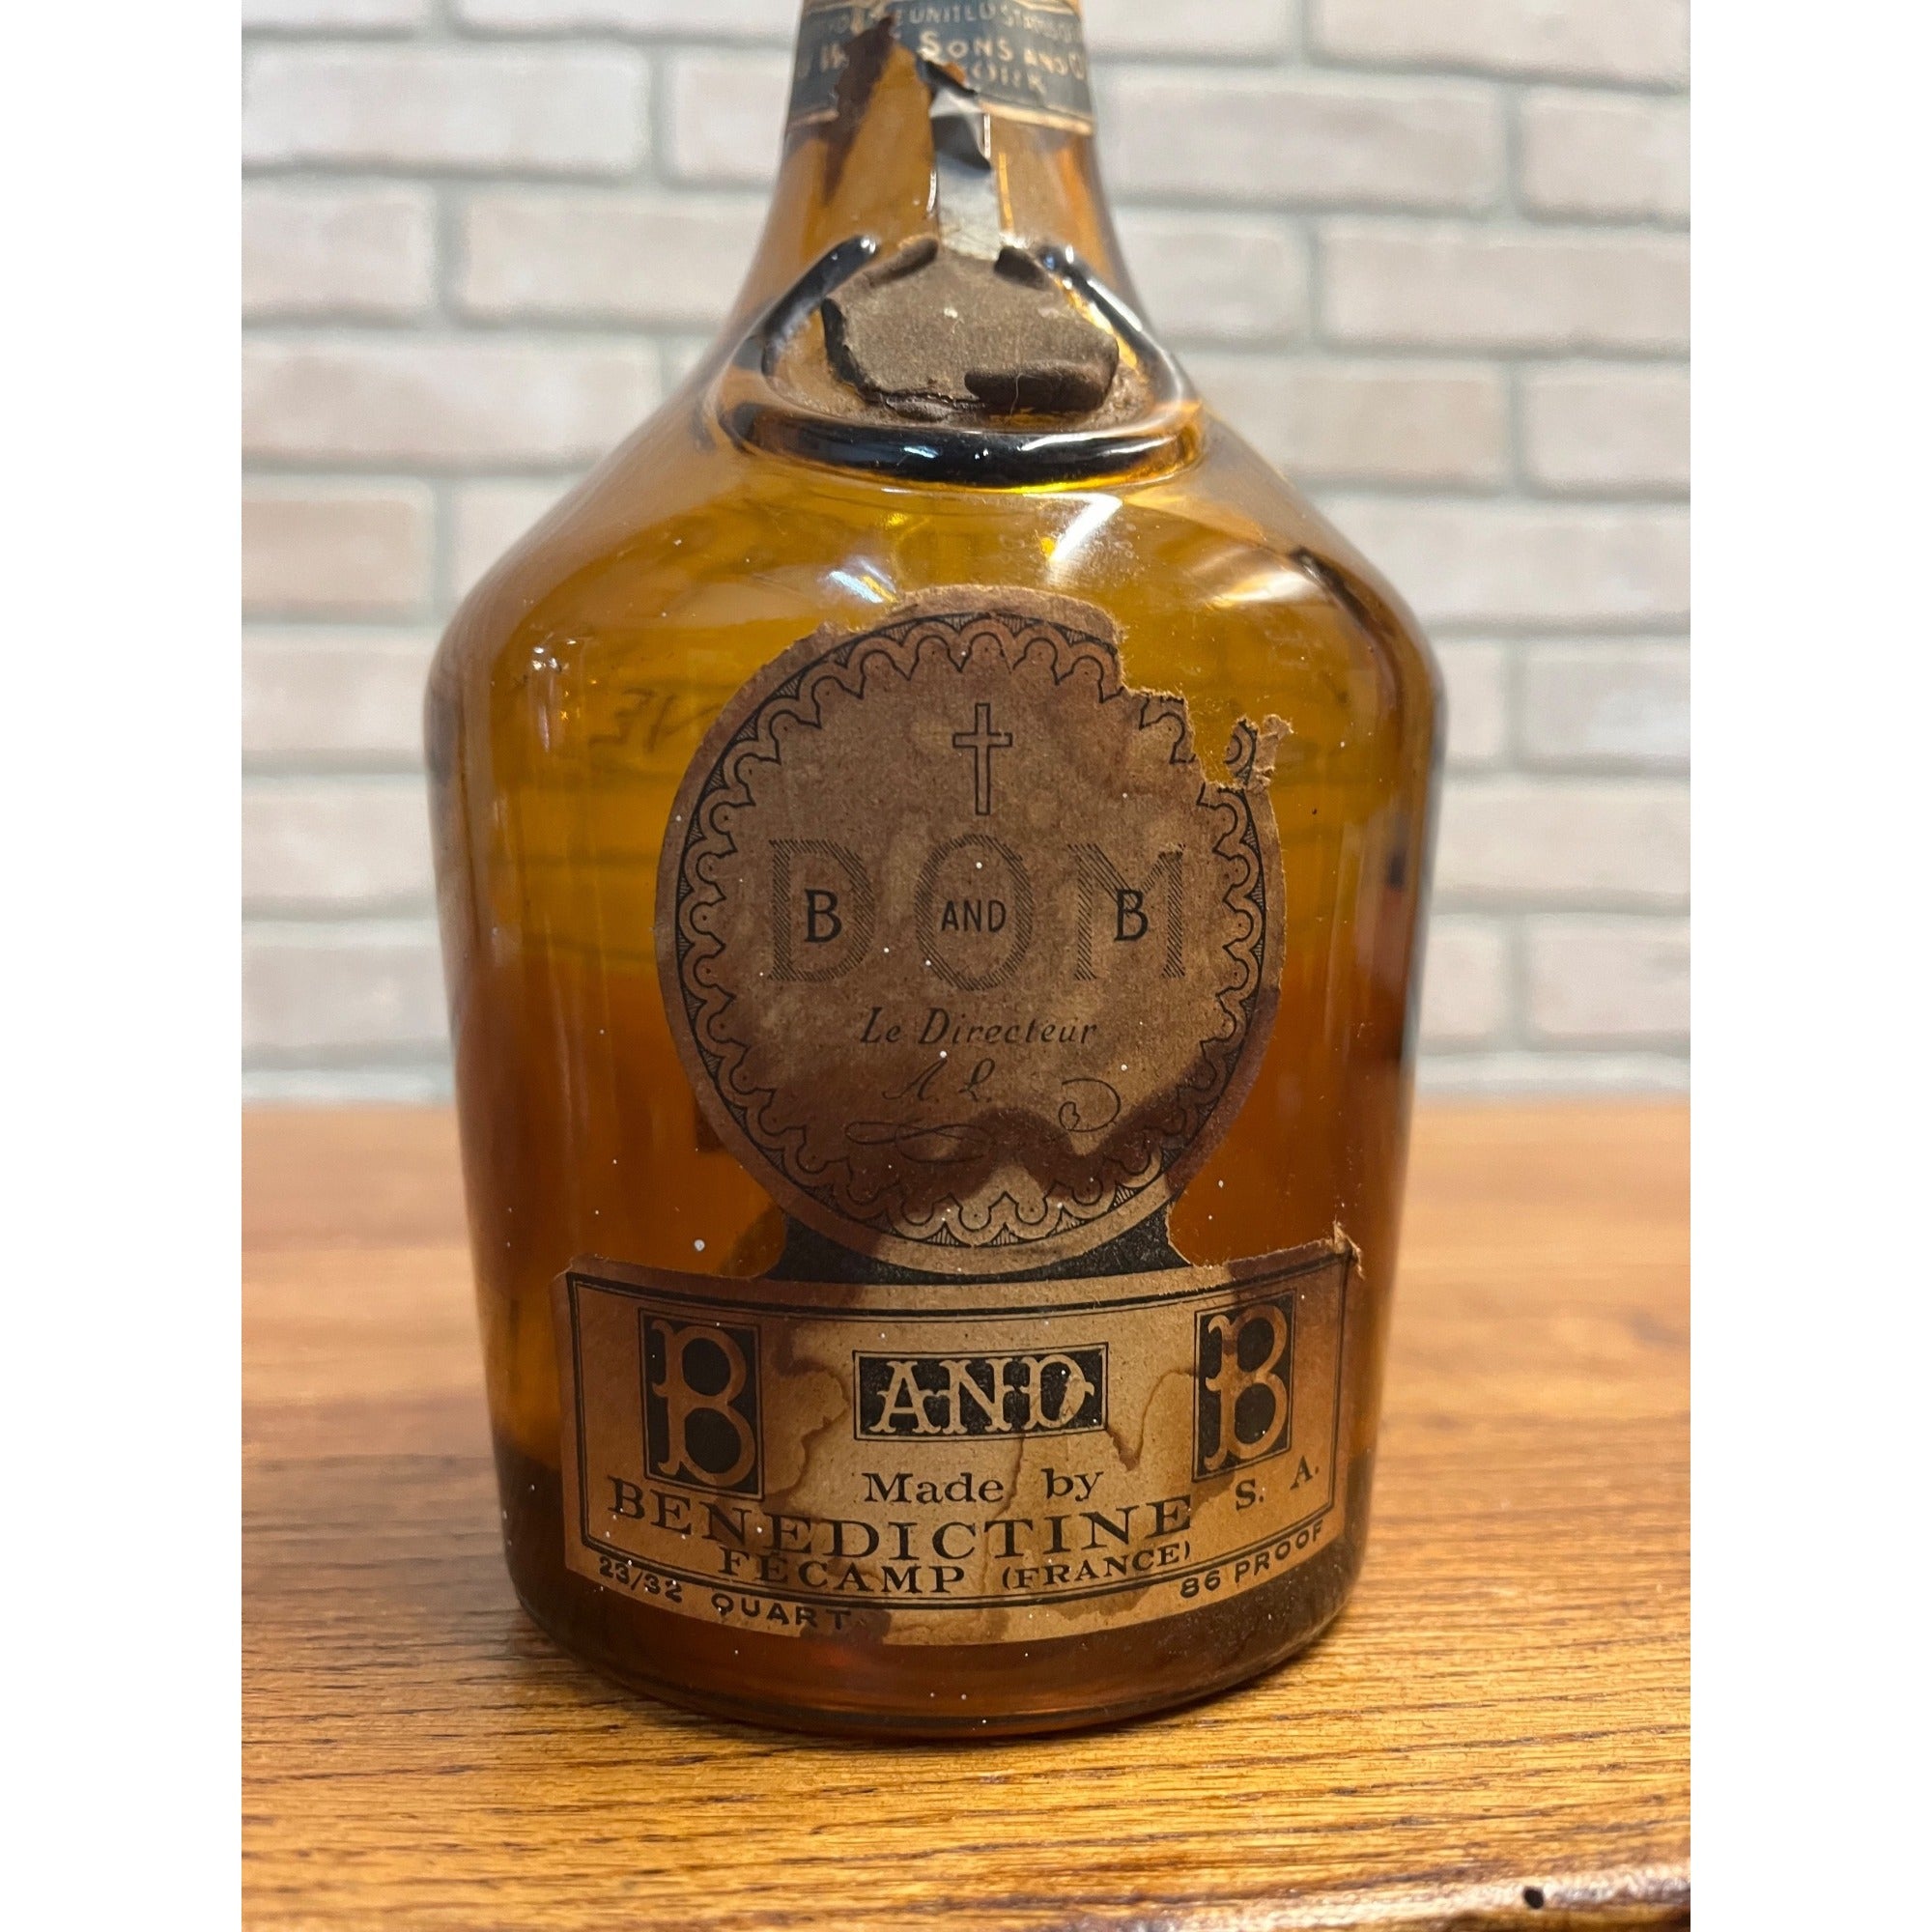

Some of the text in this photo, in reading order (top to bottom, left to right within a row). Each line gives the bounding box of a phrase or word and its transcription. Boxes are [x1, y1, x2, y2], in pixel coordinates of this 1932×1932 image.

[920, 30, 1014, 62] SONS
[804, 888, 1150, 944] B AND B
[860, 1007, 1097, 1044] Le Directeur
[650, 1304, 1288, 1489] B AND B
[607, 1454, 1321, 1564] BENEDICTINE S. A.
[862, 1467, 1104, 1505] Made by
[718, 1540, 1192, 1595] FECAMP (FRANCE)
[1179, 1519, 1324, 1600] 86 PROOF
[598, 1554, 853, 1631] 23/32 QUART
